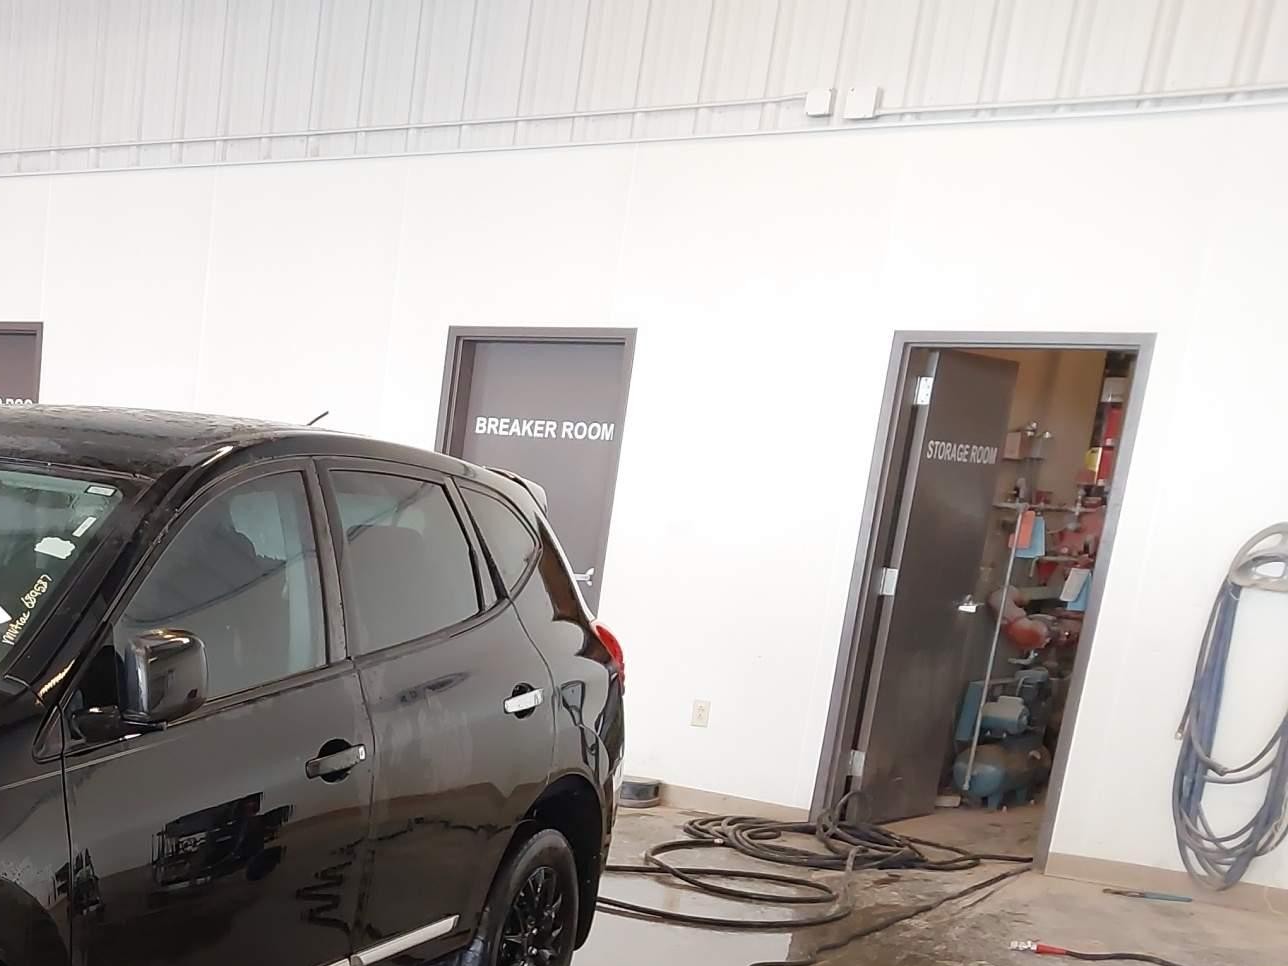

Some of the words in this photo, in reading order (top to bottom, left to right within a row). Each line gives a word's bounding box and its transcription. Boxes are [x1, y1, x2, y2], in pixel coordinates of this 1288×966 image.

[475, 416, 557, 438] BREAKER
[561, 421, 615, 441] ROOM
[926, 440, 970, 463] STORAGE
[970, 445, 998, 465] ROOM
